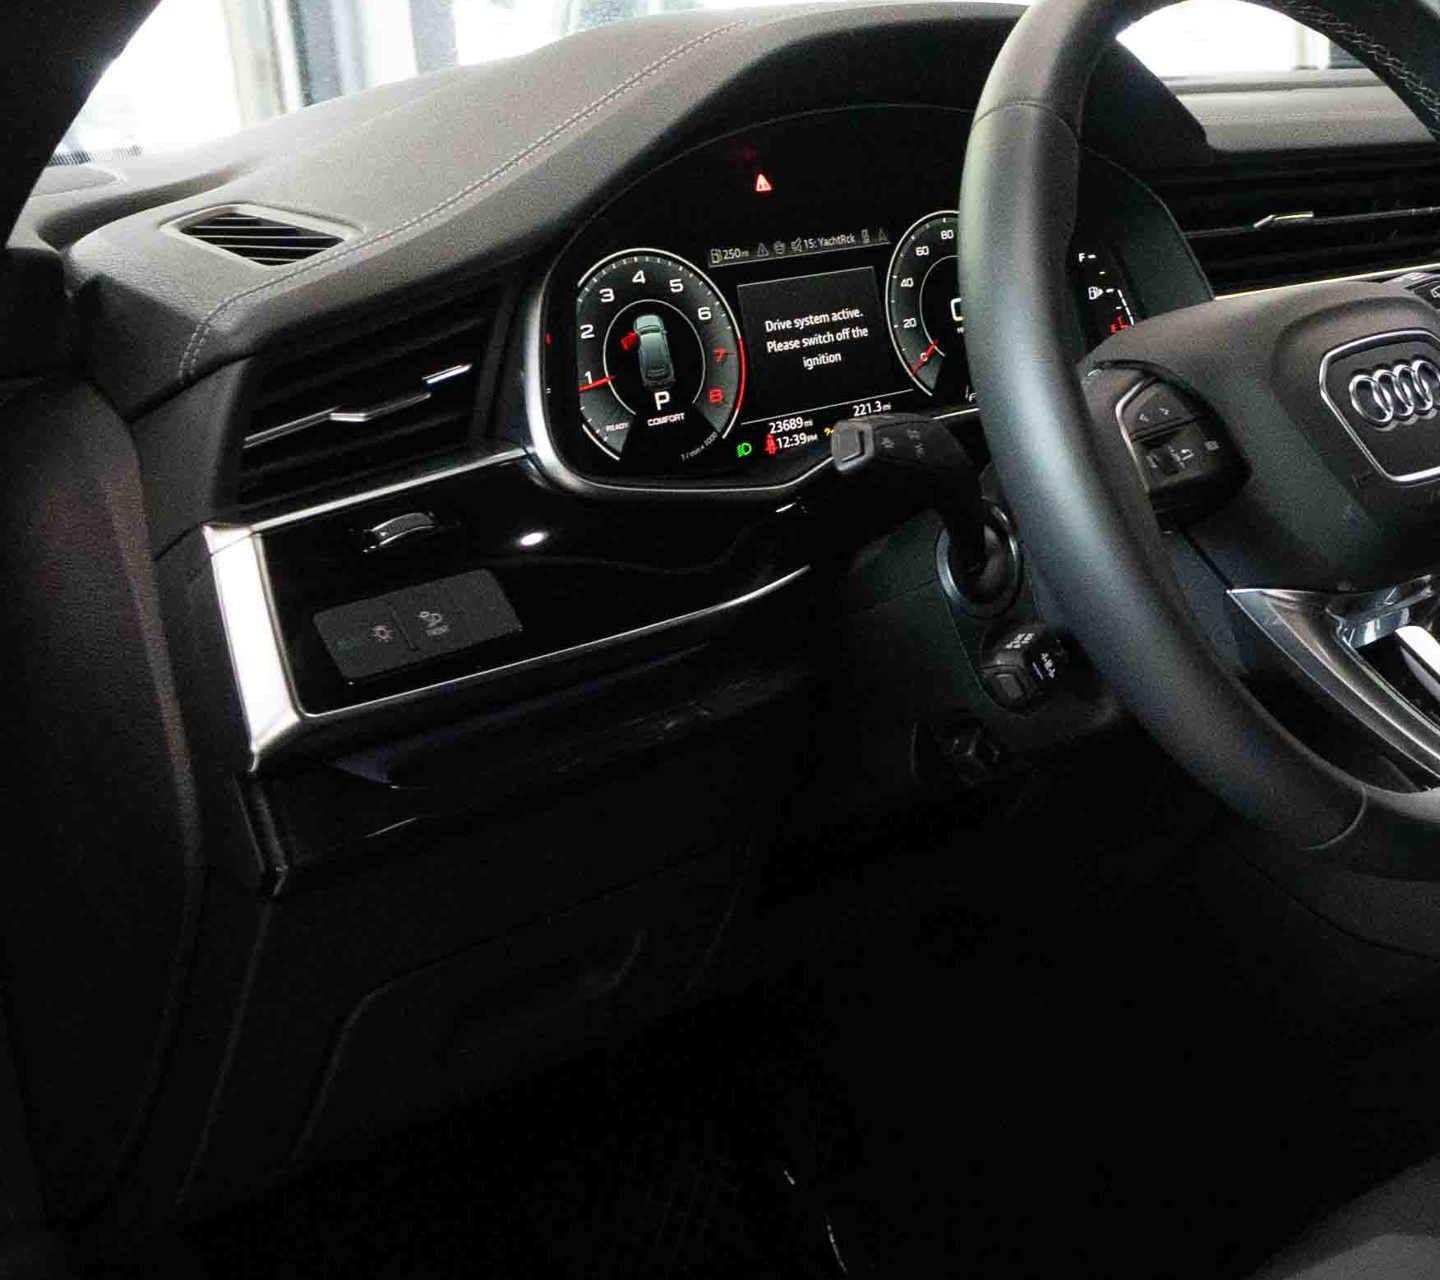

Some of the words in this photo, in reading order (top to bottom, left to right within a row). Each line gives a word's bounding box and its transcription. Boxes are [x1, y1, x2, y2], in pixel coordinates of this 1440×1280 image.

[940, 229, 954, 240] 80
[915, 246, 930, 257] 60
[632, 270, 647, 284] 4
[900, 277, 914, 288] 40
[669, 278, 684, 293] 5
[599, 288, 615, 302] 3
[697, 306, 712, 321] 6
[765, 319, 793, 333] Drive
[793, 313, 830, 330] system
[831, 308, 864, 322] active.
[903, 317, 917, 329] 20
[580, 323, 595, 339] 2
[766, 340, 801, 353] Please
[802, 331, 835, 347] switch
[836, 327, 851, 341] off
[851, 326, 869, 338] the
[713, 348, 727, 362] 7
[802, 352, 842, 370] ignition
[654, 391, 670, 410] P
[709, 390, 725, 404] 8
[647, 412, 685, 426] COMFORT
